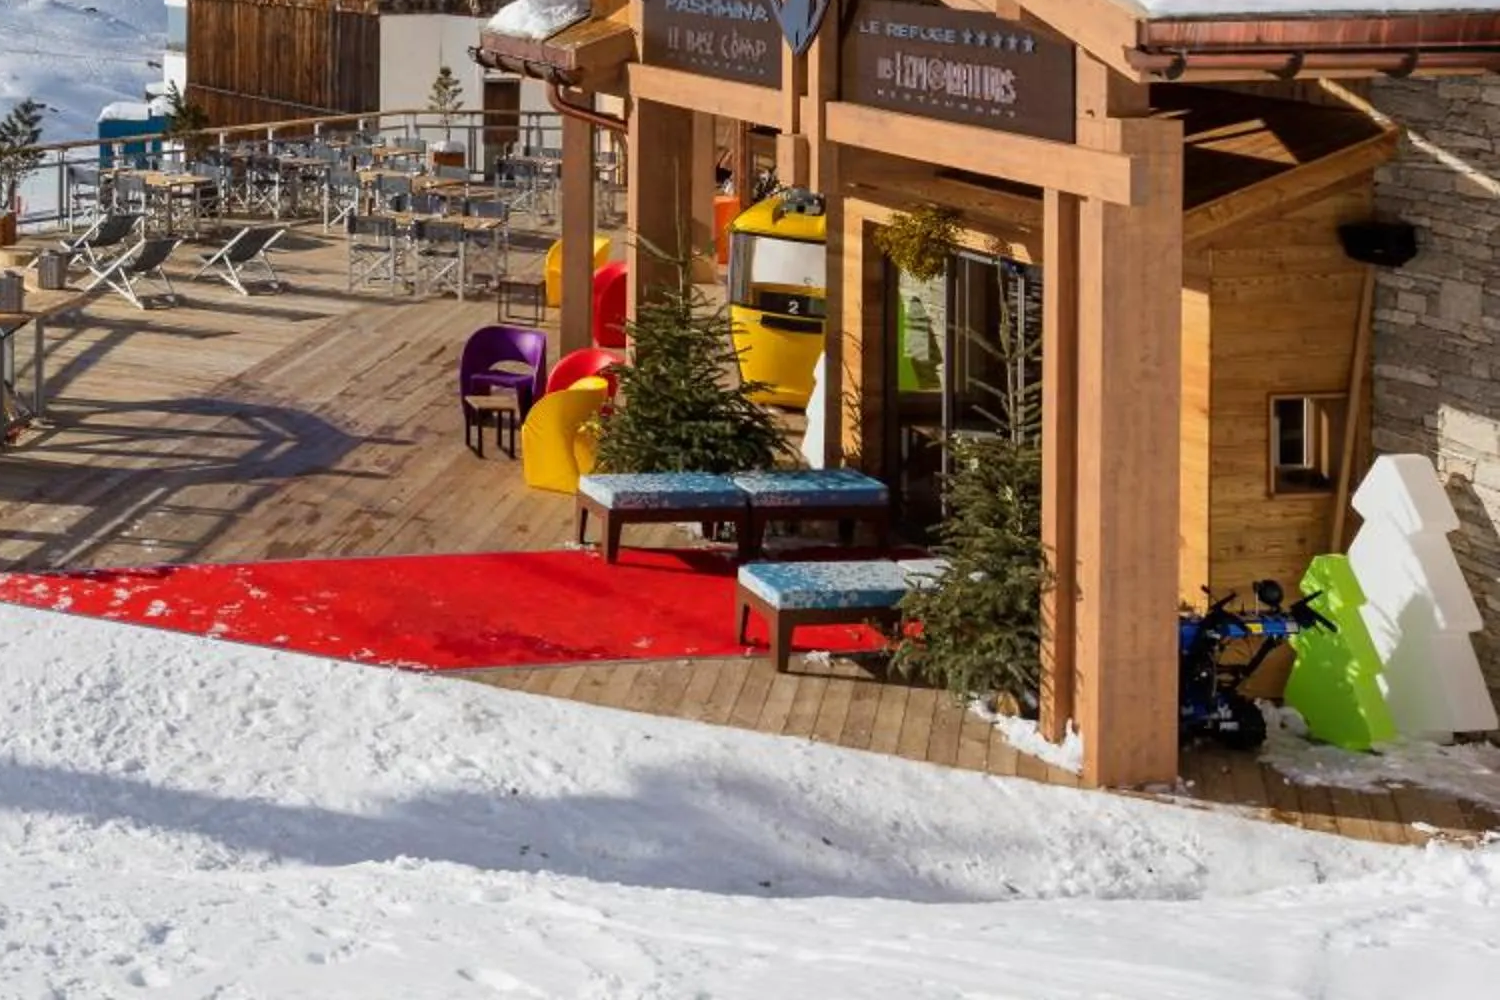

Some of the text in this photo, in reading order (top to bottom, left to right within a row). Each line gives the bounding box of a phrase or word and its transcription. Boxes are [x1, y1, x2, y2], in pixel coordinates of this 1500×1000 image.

[859, 20, 956, 43] LE REFUGE
[787, 299, 800, 315] 2
